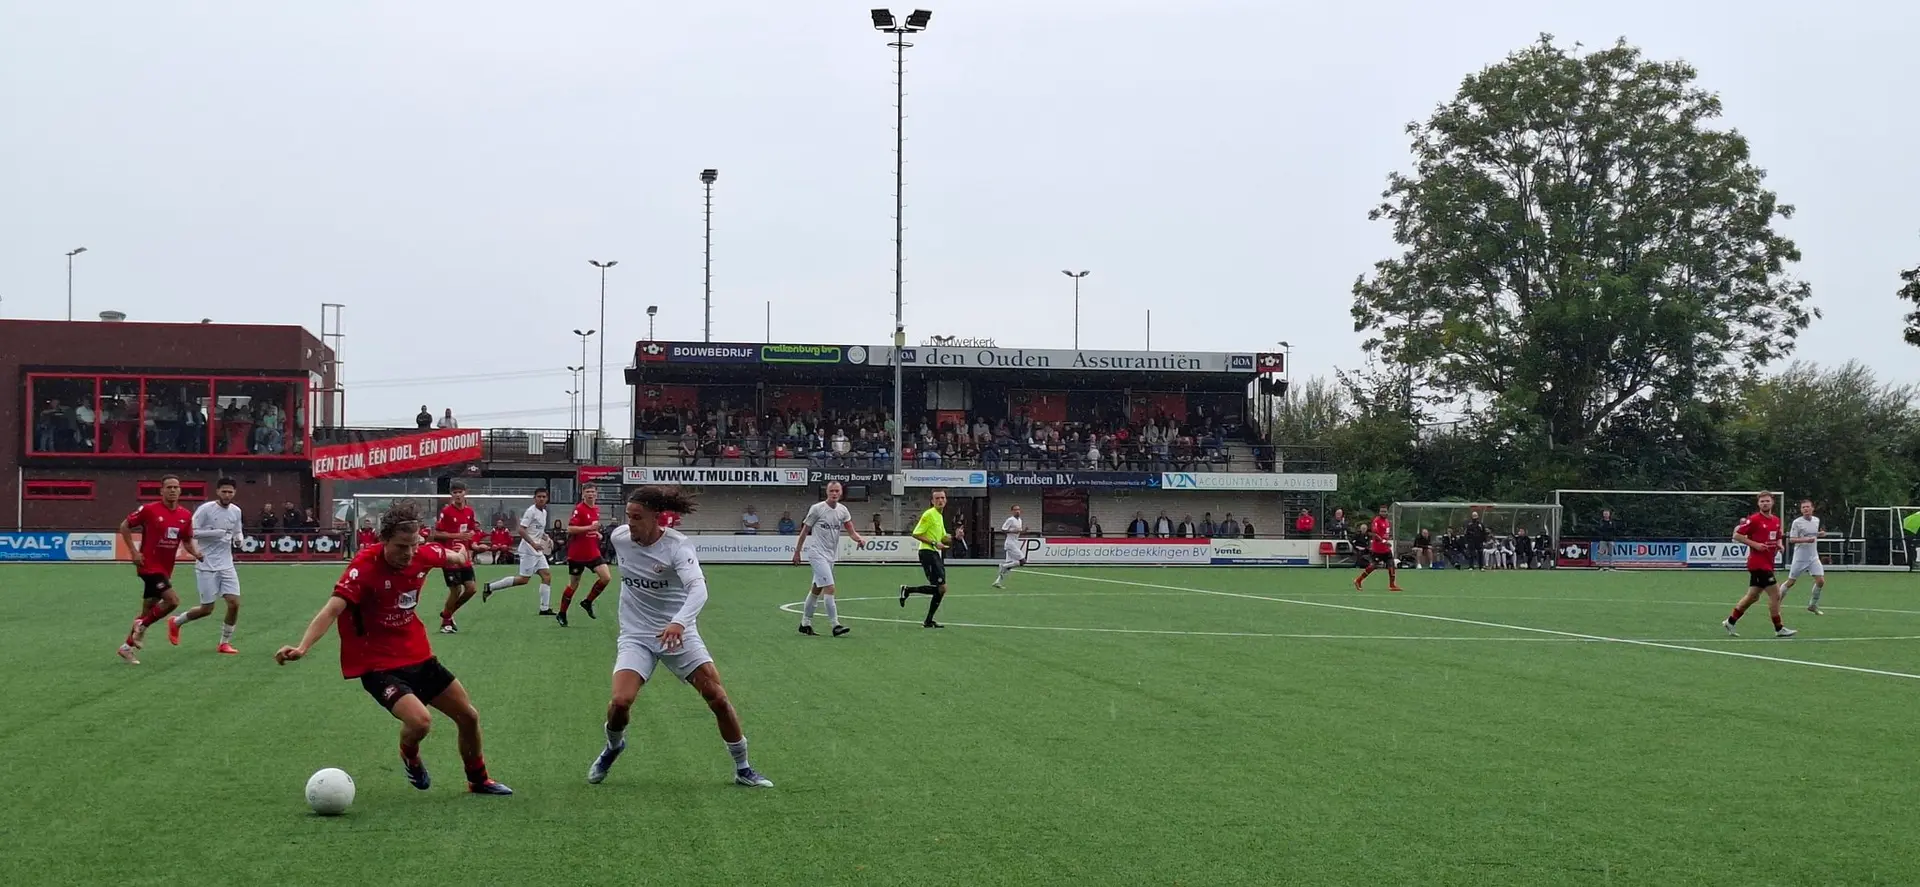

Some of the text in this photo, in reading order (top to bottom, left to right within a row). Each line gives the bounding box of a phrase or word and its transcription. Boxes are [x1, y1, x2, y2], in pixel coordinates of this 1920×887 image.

[674, 347, 753, 357] BOUWBEDRIJF
[770, 344, 820, 356] valkenburg
[900, 350, 914, 360] OA
[926, 348, 1201, 370] den Ouden Assurantiën
[337, 454, 366, 471] TEAM,
[368, 447, 387, 465] ÉÉN
[389, 444, 417, 462] DOEL,
[419, 438, 438, 457] ÉÉN
[440, 432, 479, 453] DROOM!
[653, 469, 779, 482] WWW.TMULDER.NL
[824, 473, 850, 483] Hartog
[1006, 473, 1053, 485] Berndsen
[1056, 473, 1076, 485] B.V.
[1163, 473, 1335, 488] V2N ACCOUNTANTS & ADVISEURS
[696, 540, 782, 553] dministratiekantoor
[1597, 544, 1681, 556] NI-DUMP
[1689, 545, 1748, 556] AGV AGV
[1045, 546, 1208, 561] Zuidplas dakbedekkingen BV
[621, 576, 669, 589] OSUCH
